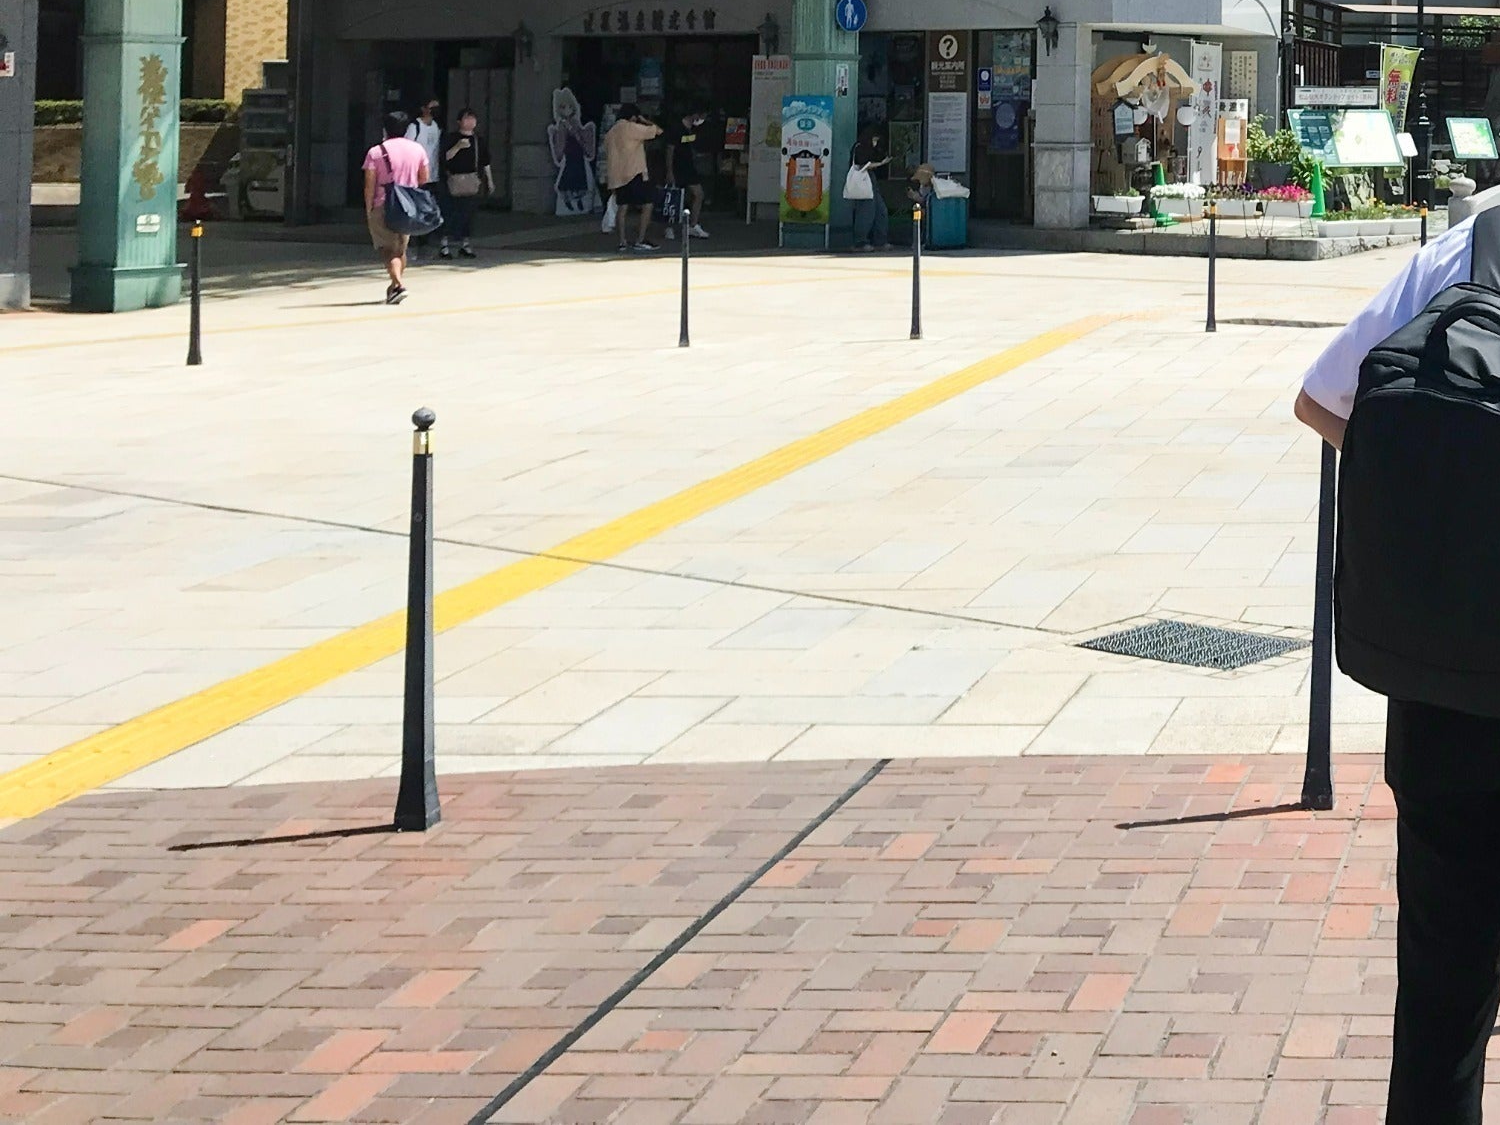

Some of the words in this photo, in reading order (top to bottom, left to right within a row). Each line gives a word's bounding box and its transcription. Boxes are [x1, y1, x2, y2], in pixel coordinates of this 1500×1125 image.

[931, 61, 965, 70] 観光案内所
[1386, 68, 1401, 103] 無料
